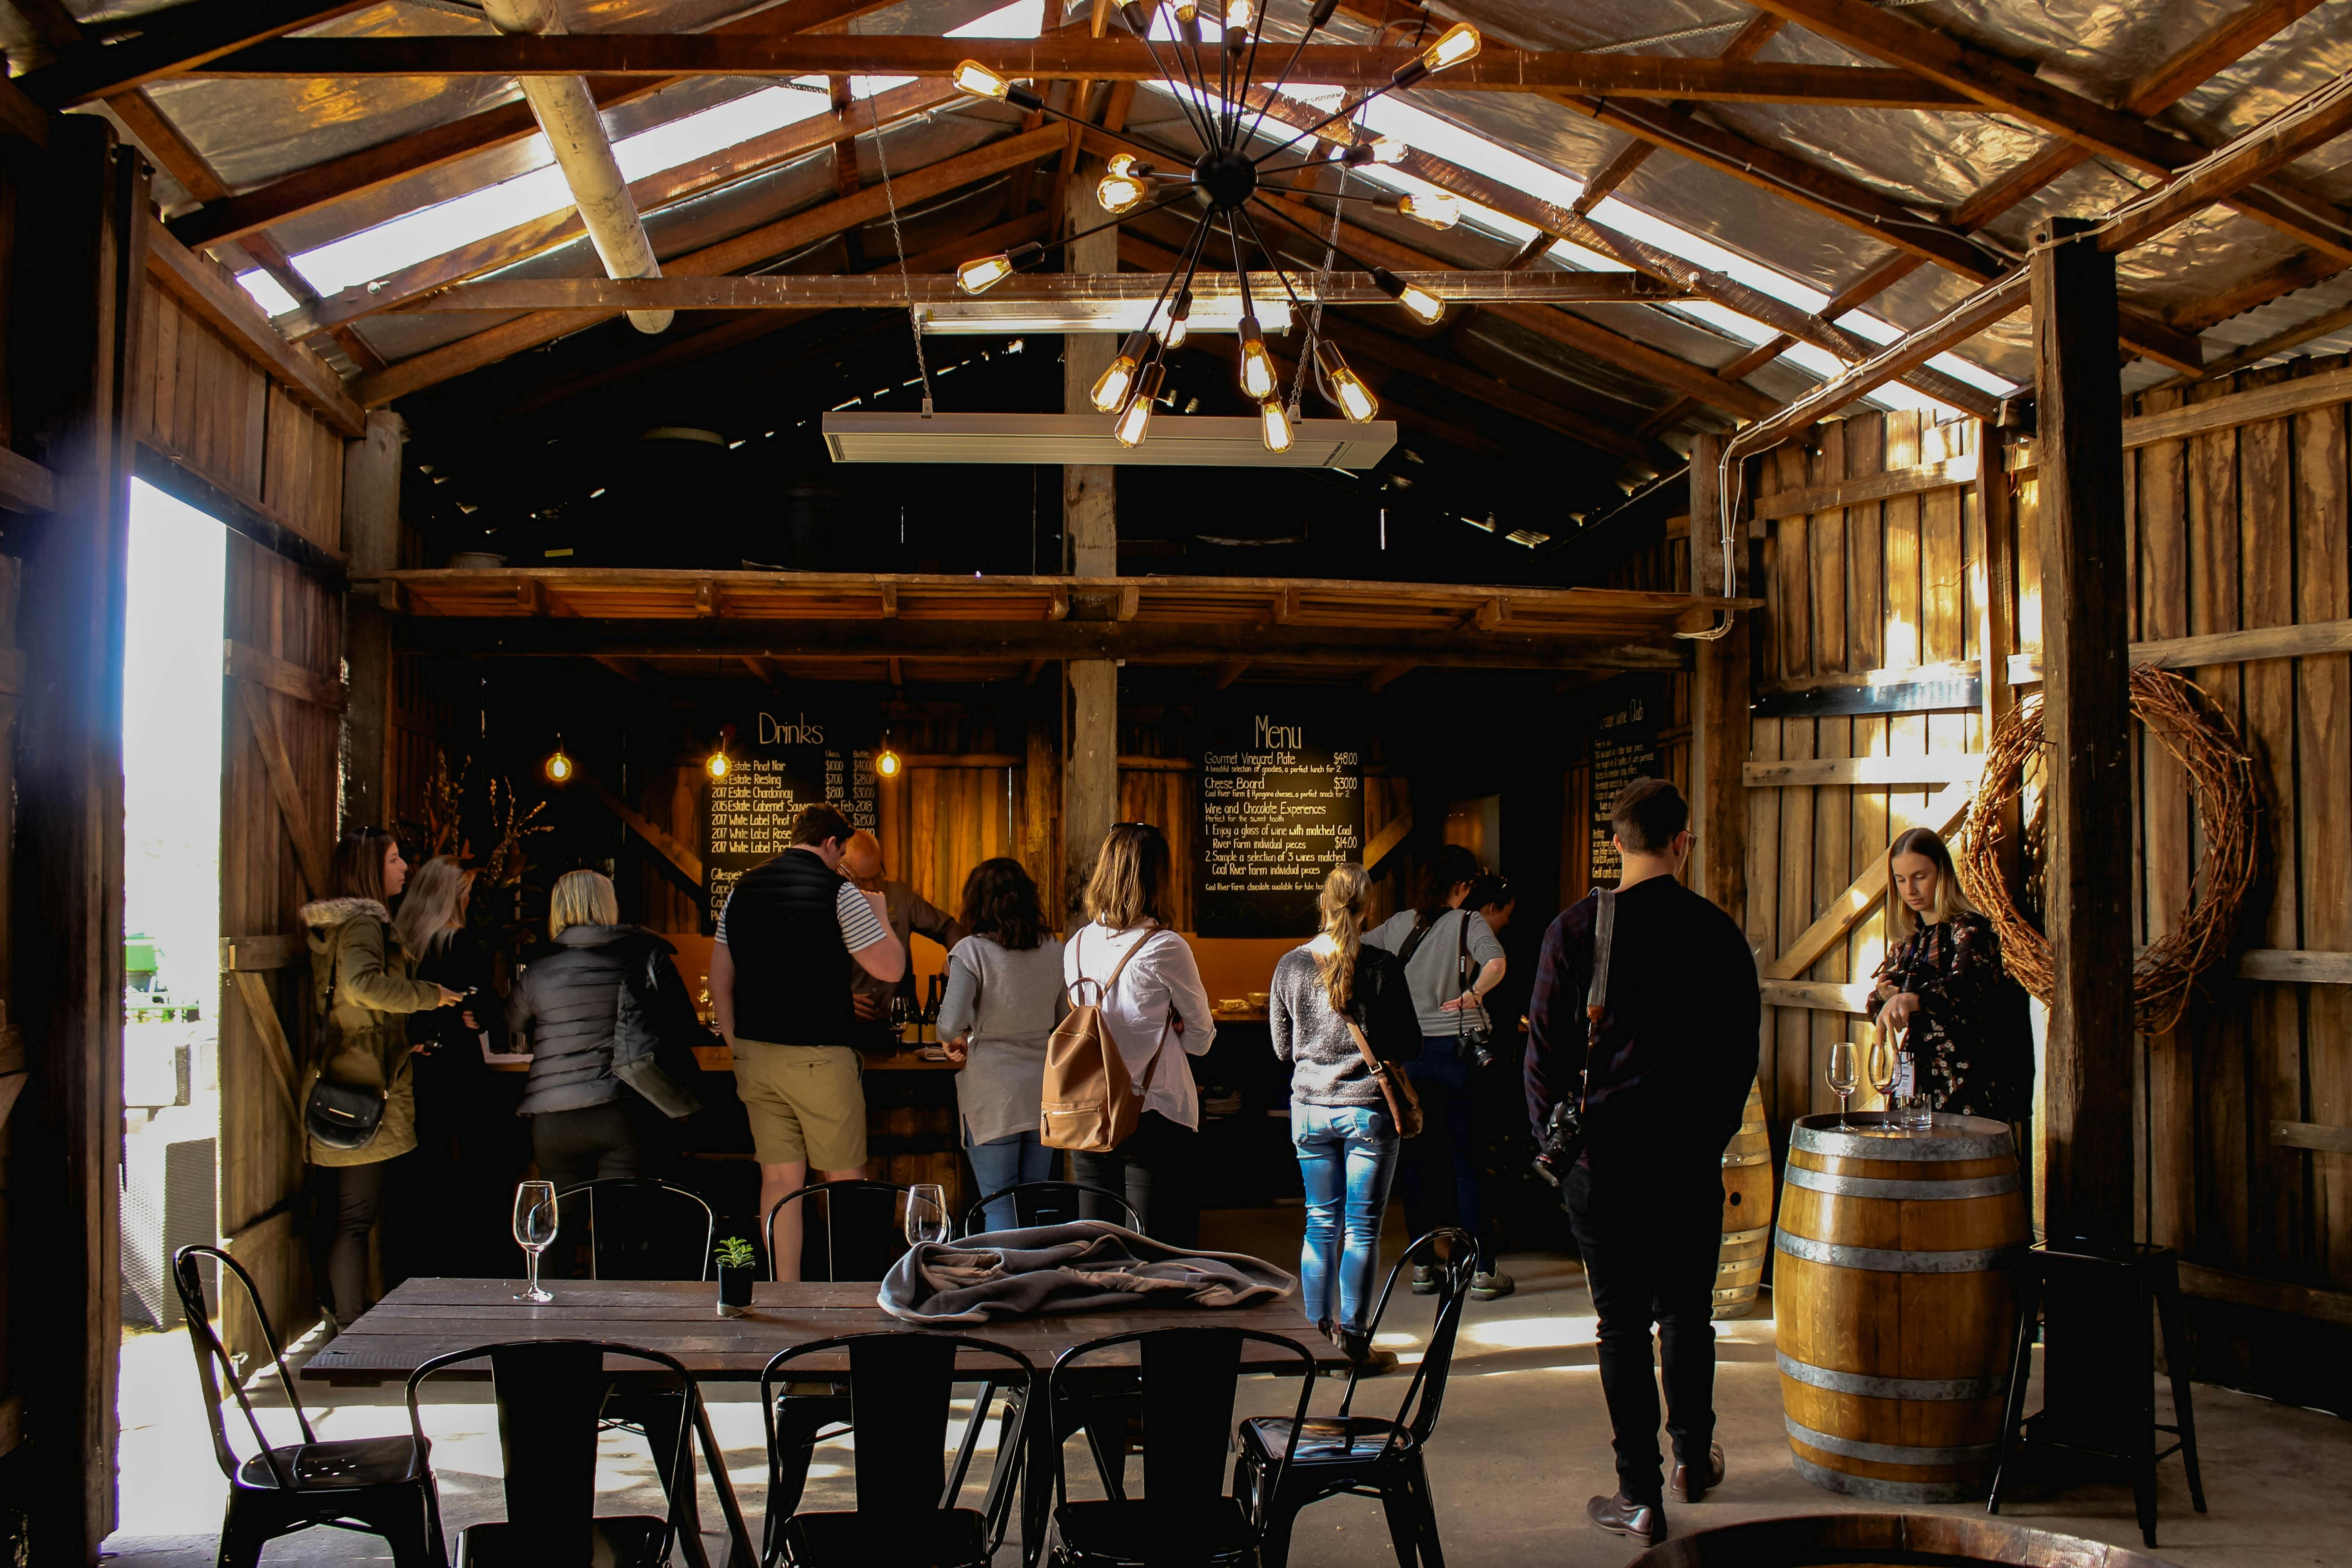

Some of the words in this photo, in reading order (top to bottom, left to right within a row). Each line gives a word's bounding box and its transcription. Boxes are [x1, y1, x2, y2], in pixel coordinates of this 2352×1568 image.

[1630, 699, 1643, 721] Club
[759, 712, 823, 744] Drinks
[1255, 715, 1302, 749] Menu
[853, 750, 870, 758] Bottle
[1205, 752, 1238, 764] Gourmet
[1241, 752, 1273, 767] Vineyard
[1277, 751, 1296, 764] Plate
[731, 761, 750, 771] Estate
[754, 760, 770, 771] Pinot
[772, 760, 786, 771] Noir
[1262, 765, 1283, 776] goodies,
[1290, 765, 1308, 774] perfect
[729, 774, 751, 784] Estate
[754, 774, 781, 788] Riesling
[1205, 777, 1233, 789] Cheese
[1236, 777, 1264, 789] Board
[712, 787, 726, 798] 2017
[729, 787, 751, 798] Estate
[753, 787, 793, 800] Chardonnay
[1252, 790, 1274, 799] Pyengana
[1300, 790, 1317, 799] perfect
[712, 800, 727, 811] 2015
[728, 799, 750, 811] Estate
[753, 800, 784, 812] Cabernet
[841, 800, 854, 812] Feb
[855, 801, 872, 812] 2018
[1205, 803, 1221, 814] Wine
[1225, 801, 1239, 813] and
[1244, 801, 1277, 814] Chocolate
[1280, 801, 1326, 817] Experiences
[712, 814, 727, 825] 2017
[729, 814, 748, 825] White
[750, 814, 769, 825] Label
[773, 814, 789, 825] Pinot
[712, 828, 727, 839] 2017
[730, 828, 748, 839] White
[751, 828, 769, 839] Label
[1213, 824, 1231, 838] Enjoy
[1241, 824, 1259, 838] glass
[1261, 824, 1270, 835] of
[1271, 827, 1287, 835] wine
[1289, 824, 1303, 835] with
[1306, 824, 1335, 836] matched
[1338, 824, 1352, 835] Coal
[712, 842, 727, 853] 2017
[729, 841, 748, 853] White
[751, 841, 769, 853] Label
[1213, 838, 1231, 848] River
[1234, 838, 1250, 848] Farm
[1254, 838, 1282, 849] individual
[1286, 842, 1306, 851] pieces
[1334, 836, 1357, 850] $14.00
[1212, 850, 1237, 864] Sample
[1247, 851, 1276, 862] selection
[1278, 851, 1286, 862] of
[1288, 852, 1293, 861] 3
[1318, 850, 1346, 862] matched
[1212, 864, 1227, 875] Coal
[1230, 863, 1246, 875] River
[1249, 863, 1267, 875] Farm
[1270, 863, 1298, 875] individual
[1301, 867, 1320, 878] pieces
[1592, 866, 1602, 878] Credit
[711, 882, 730, 898] Cape
[1247, 882, 1270, 891] chocolate
[1272, 882, 1293, 890] available
[1295, 882, 1303, 890] for
[711, 896, 725, 907] Cap
